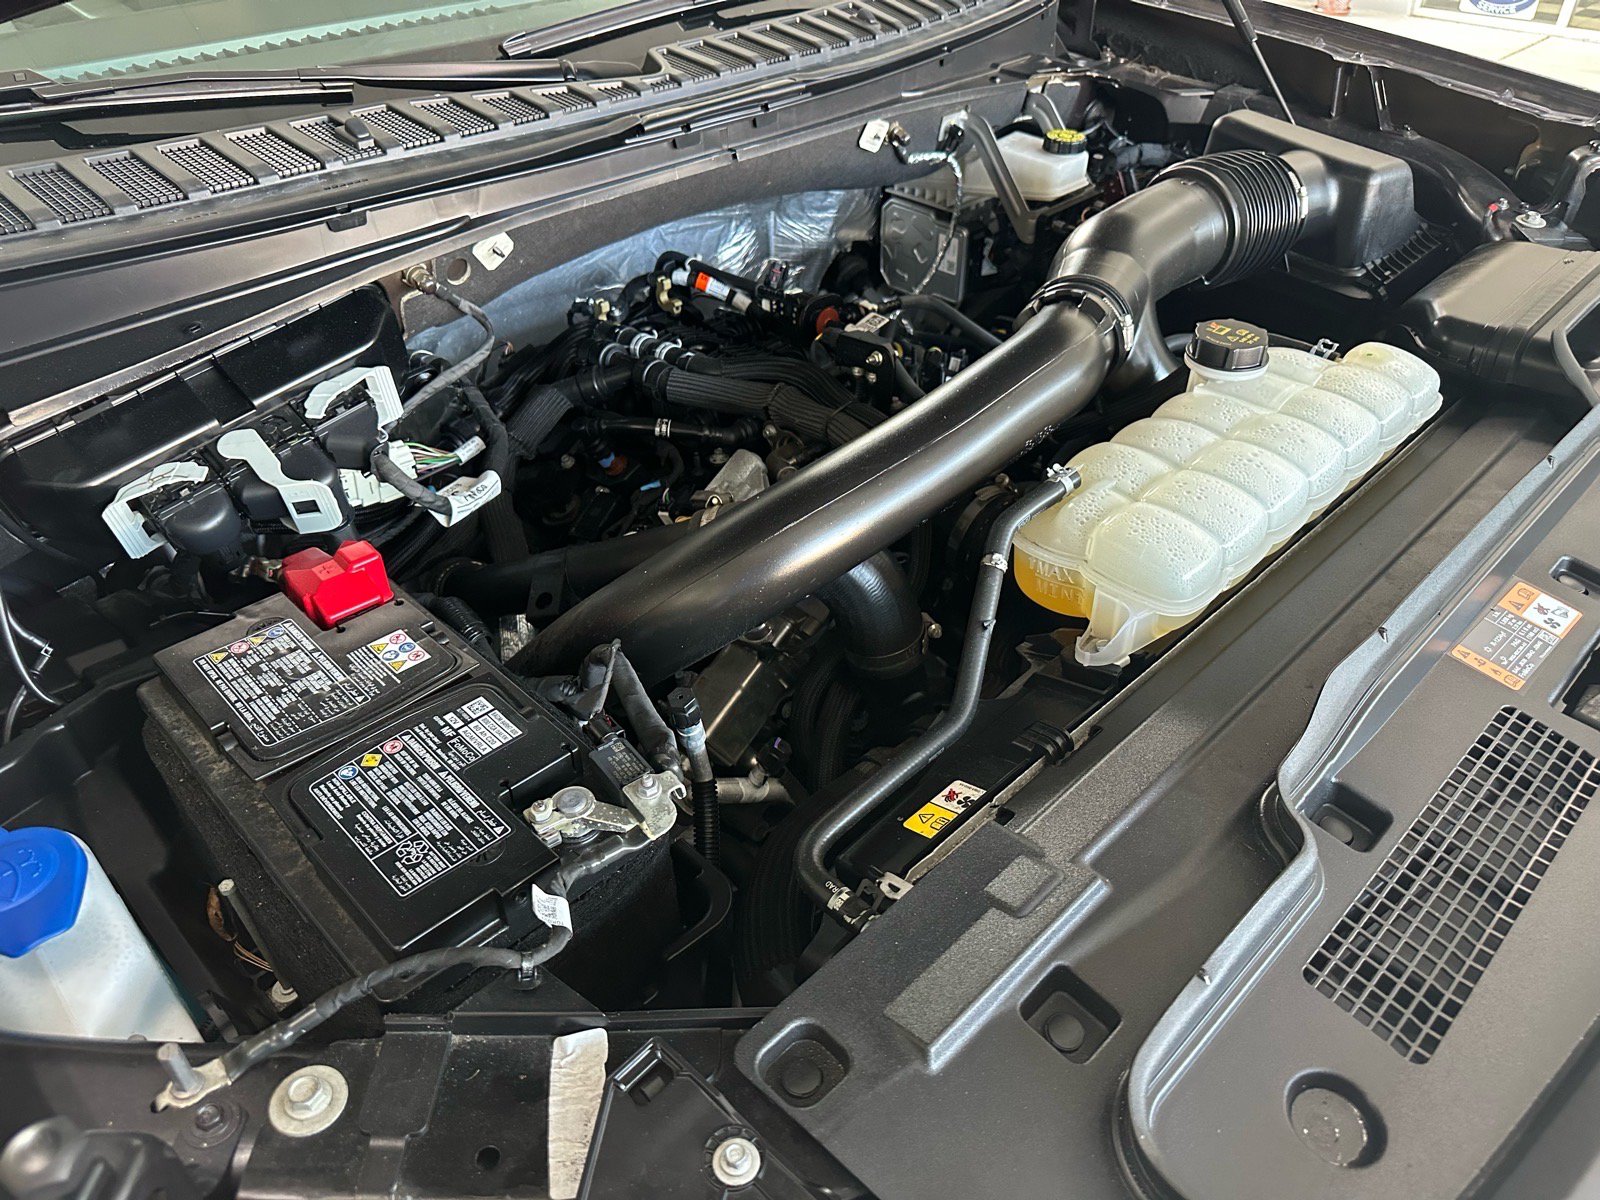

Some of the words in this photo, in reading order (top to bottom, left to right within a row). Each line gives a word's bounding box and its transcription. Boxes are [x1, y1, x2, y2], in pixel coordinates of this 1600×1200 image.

[1037, 561, 1075, 583] MAX
[447, 716, 460, 725] 12V
[438, 725, 457, 738] MF
[449, 738, 477, 761] FoMoCo
[825, 881, 839, 893] RAD
